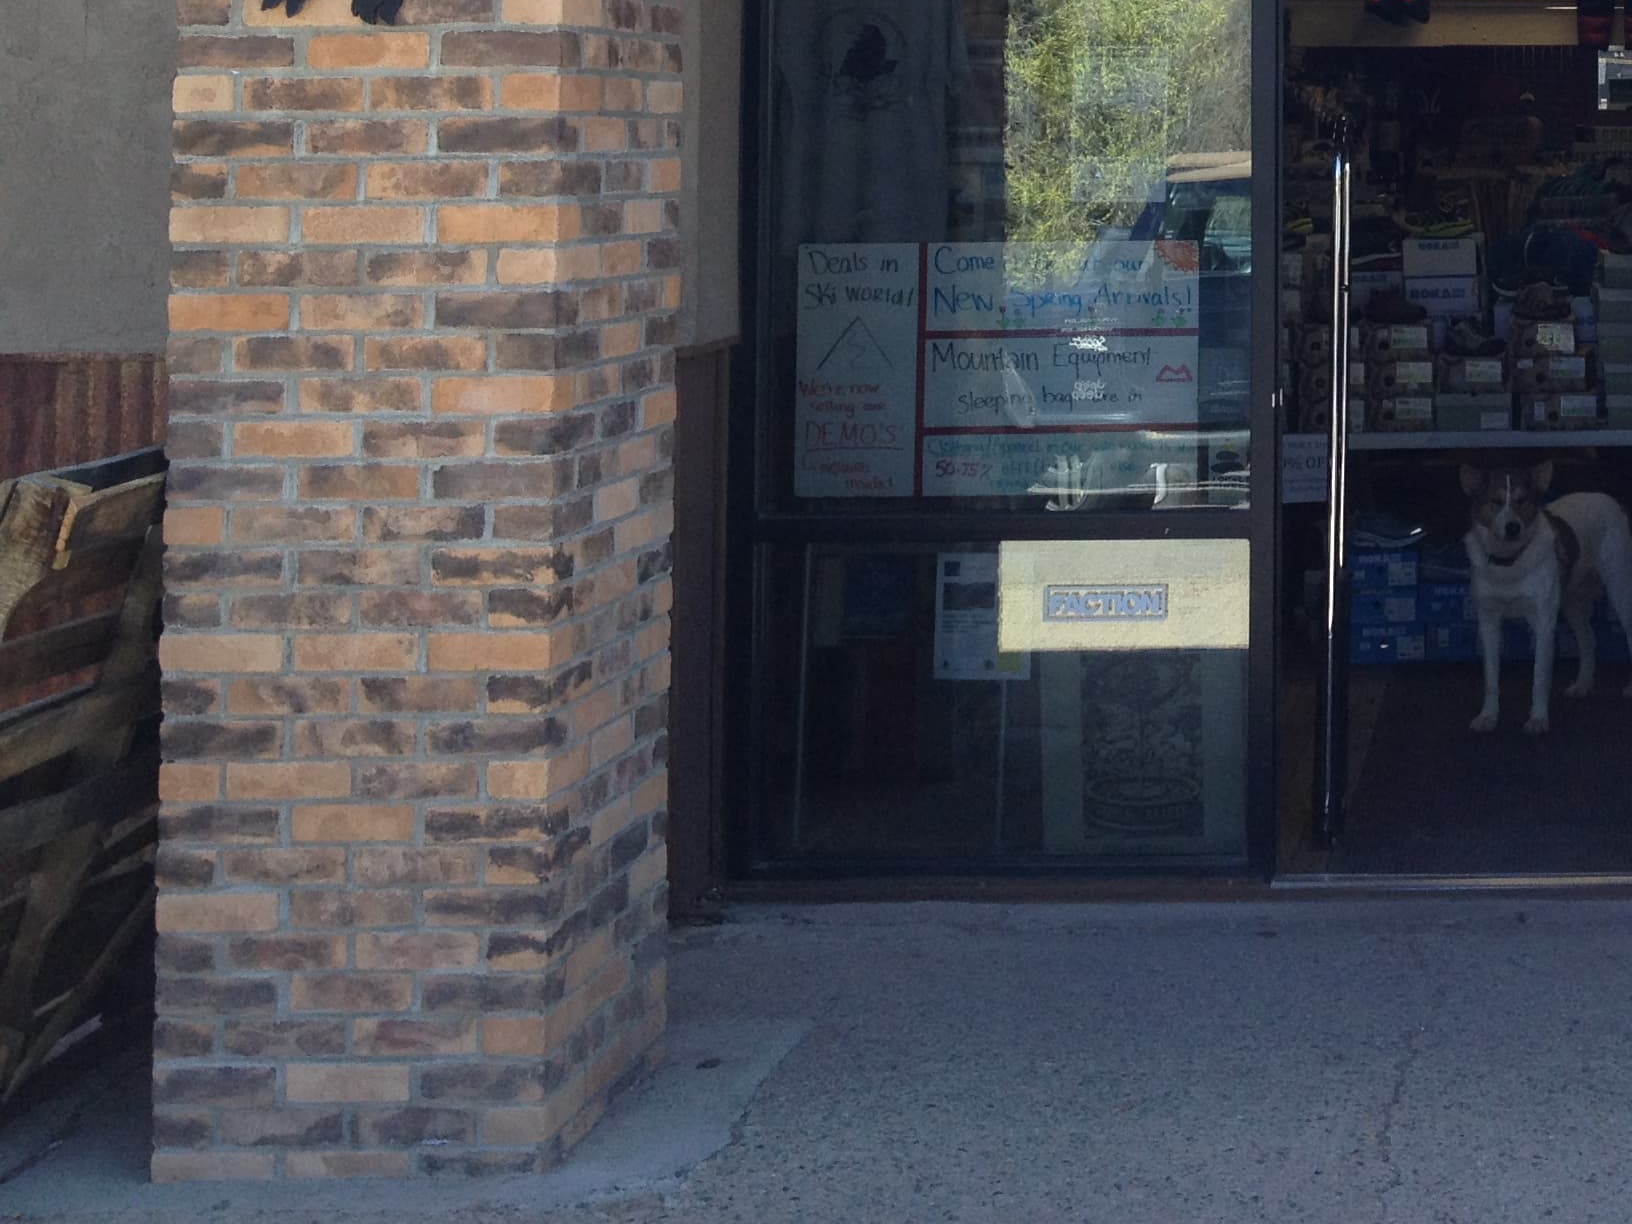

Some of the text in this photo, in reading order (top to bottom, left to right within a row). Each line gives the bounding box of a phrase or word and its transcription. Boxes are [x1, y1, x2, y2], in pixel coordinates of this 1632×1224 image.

[808, 250, 899, 274] Deals in
[934, 246, 994, 275] Come
[933, 285, 994, 315] New
[931, 341, 1152, 377] Mountain Equipment
[1049, 591, 1163, 614] FACTION
